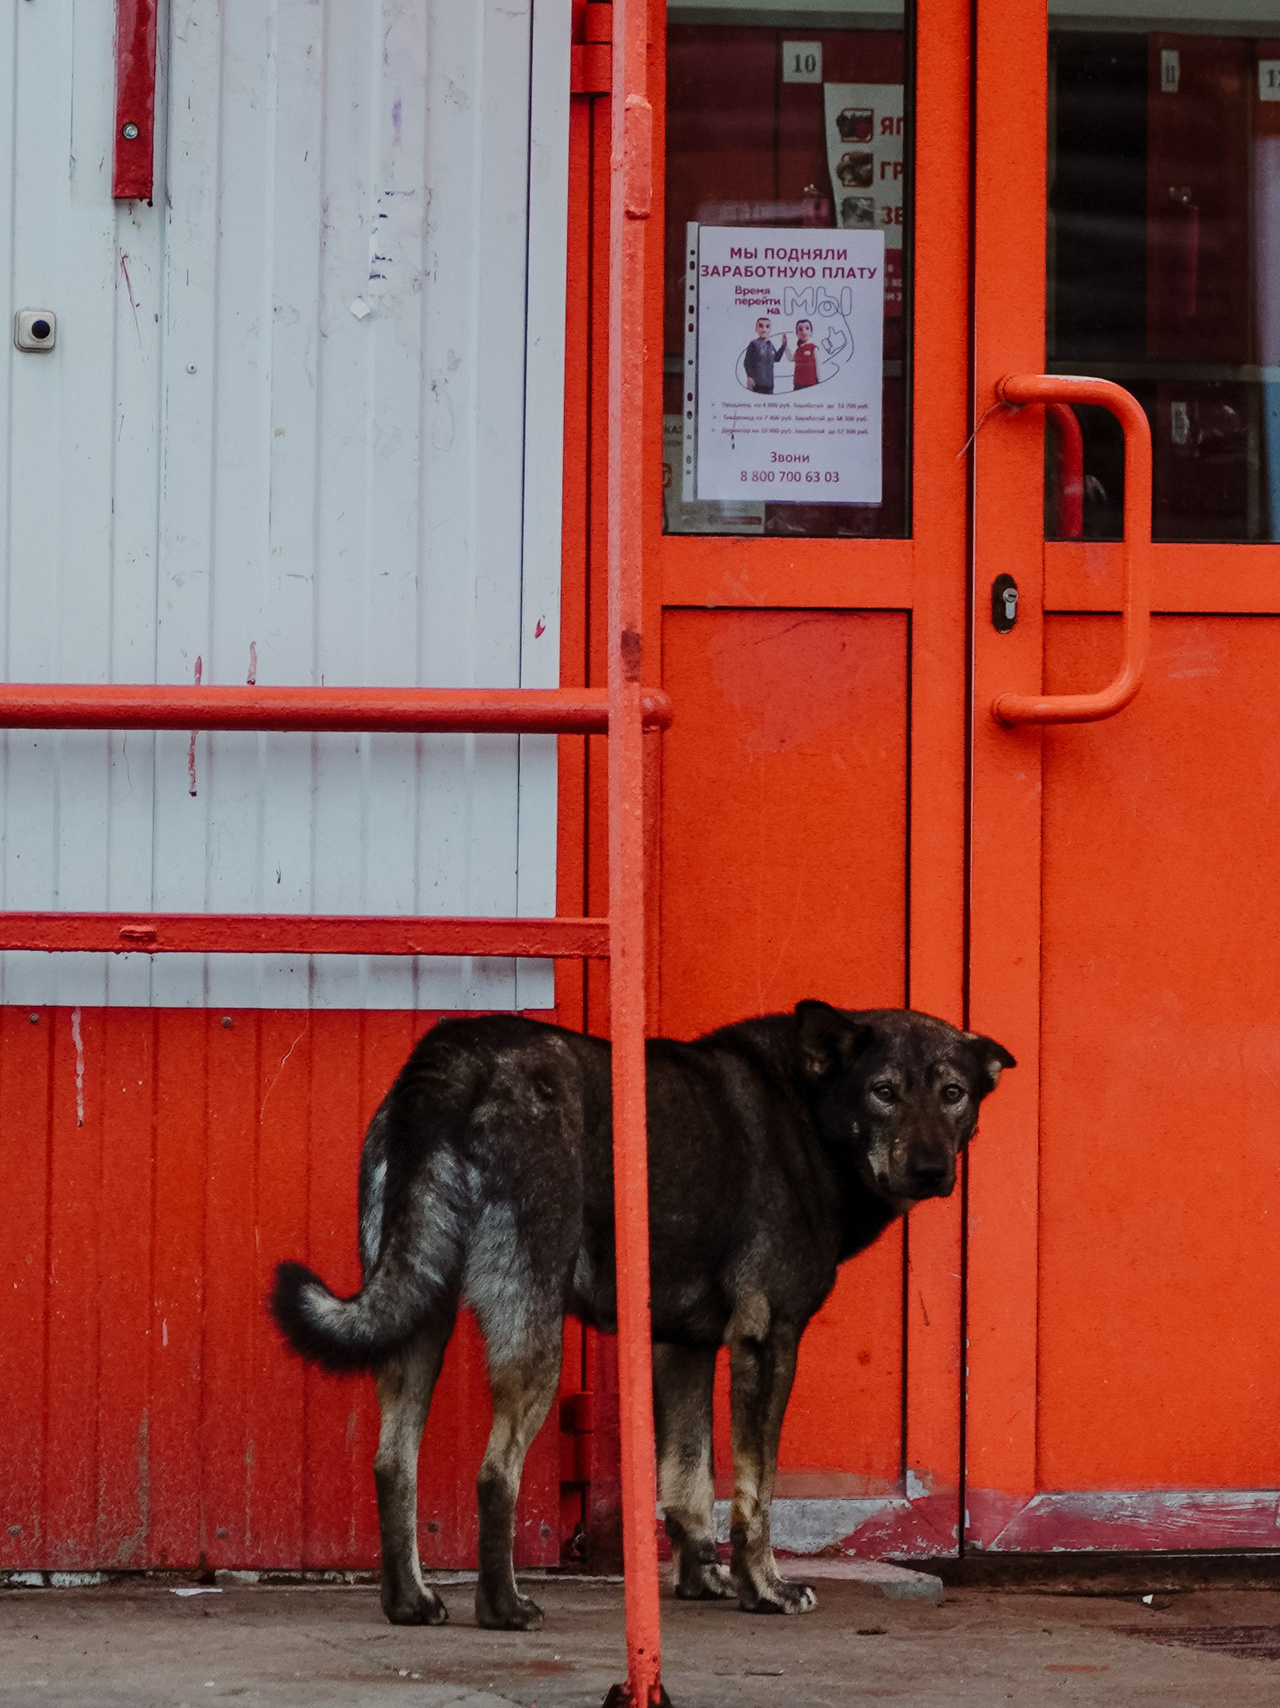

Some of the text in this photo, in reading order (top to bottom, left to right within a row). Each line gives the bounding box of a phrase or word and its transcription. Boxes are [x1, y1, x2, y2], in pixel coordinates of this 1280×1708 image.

[792, 53, 817, 74] 10
[730, 247, 848, 262] МЫ ПОДНЯЛИ
[700, 265, 878, 279] ЗАРАБОТНУЮ ПЛАТУ
[734, 285, 771, 297] Время
[734, 296, 781, 308] перейти
[766, 306, 781, 316] на
[770, 451, 810, 463] Звони
[740, 471, 840, 483] 8 800 700 63 03
